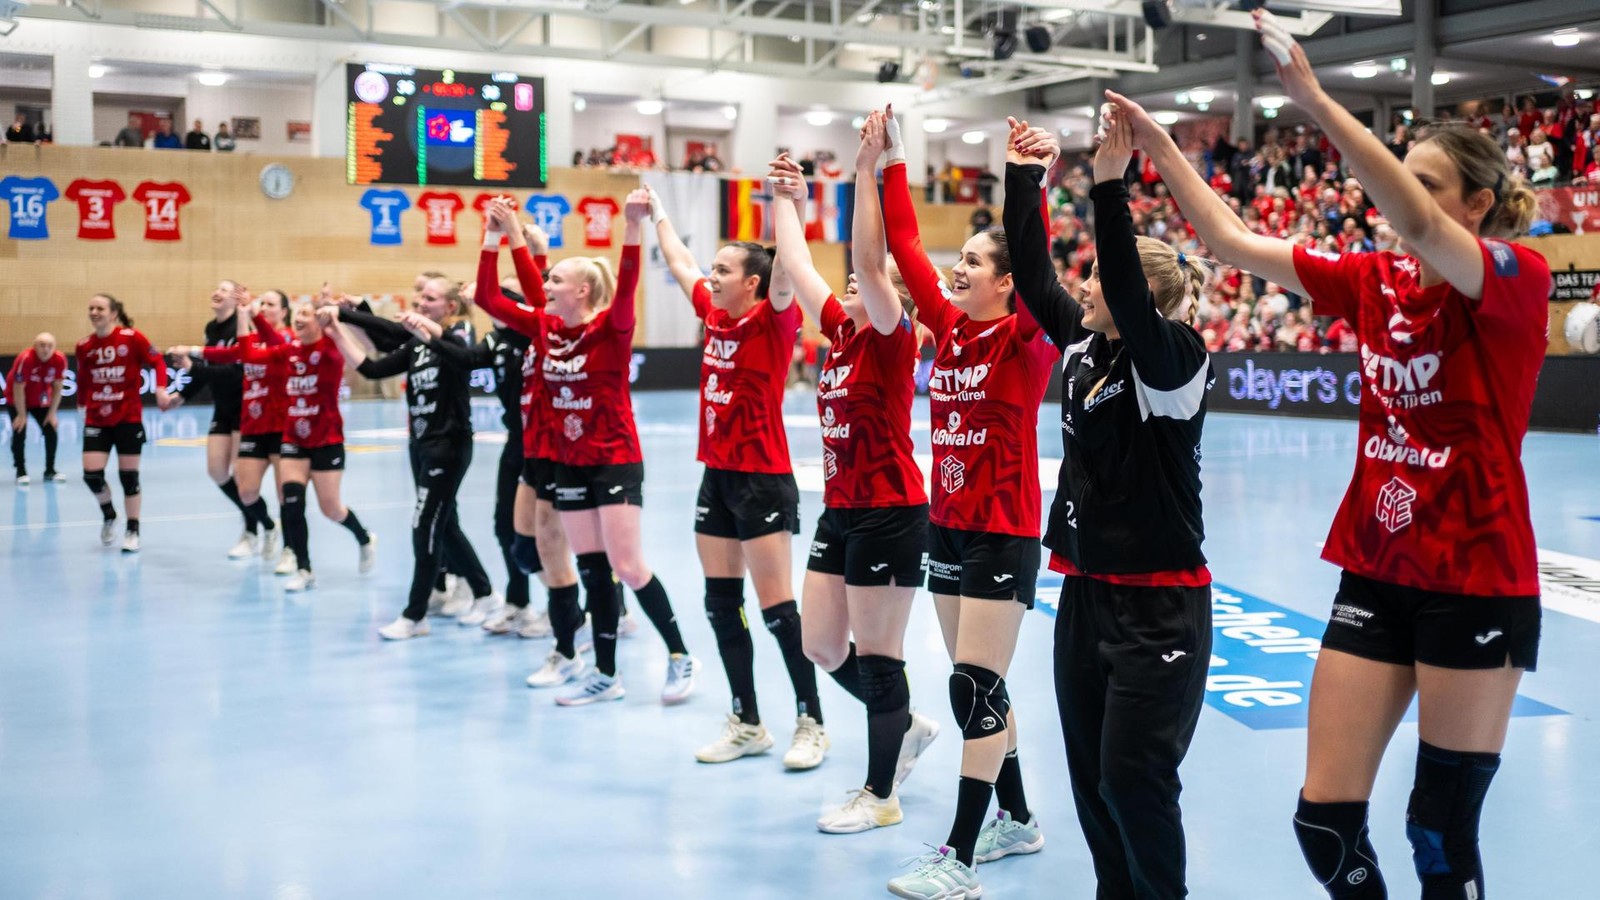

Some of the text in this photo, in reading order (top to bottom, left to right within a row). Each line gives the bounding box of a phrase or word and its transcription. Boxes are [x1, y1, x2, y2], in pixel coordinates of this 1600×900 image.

[13, 195, 43, 218] 16
[88, 196, 105, 220] 3
[1573, 192, 1600, 207] UN
[148, 199, 178, 222] 14
[1557, 273, 1600, 288] DAS TEA
[96, 346, 116, 364] 19
